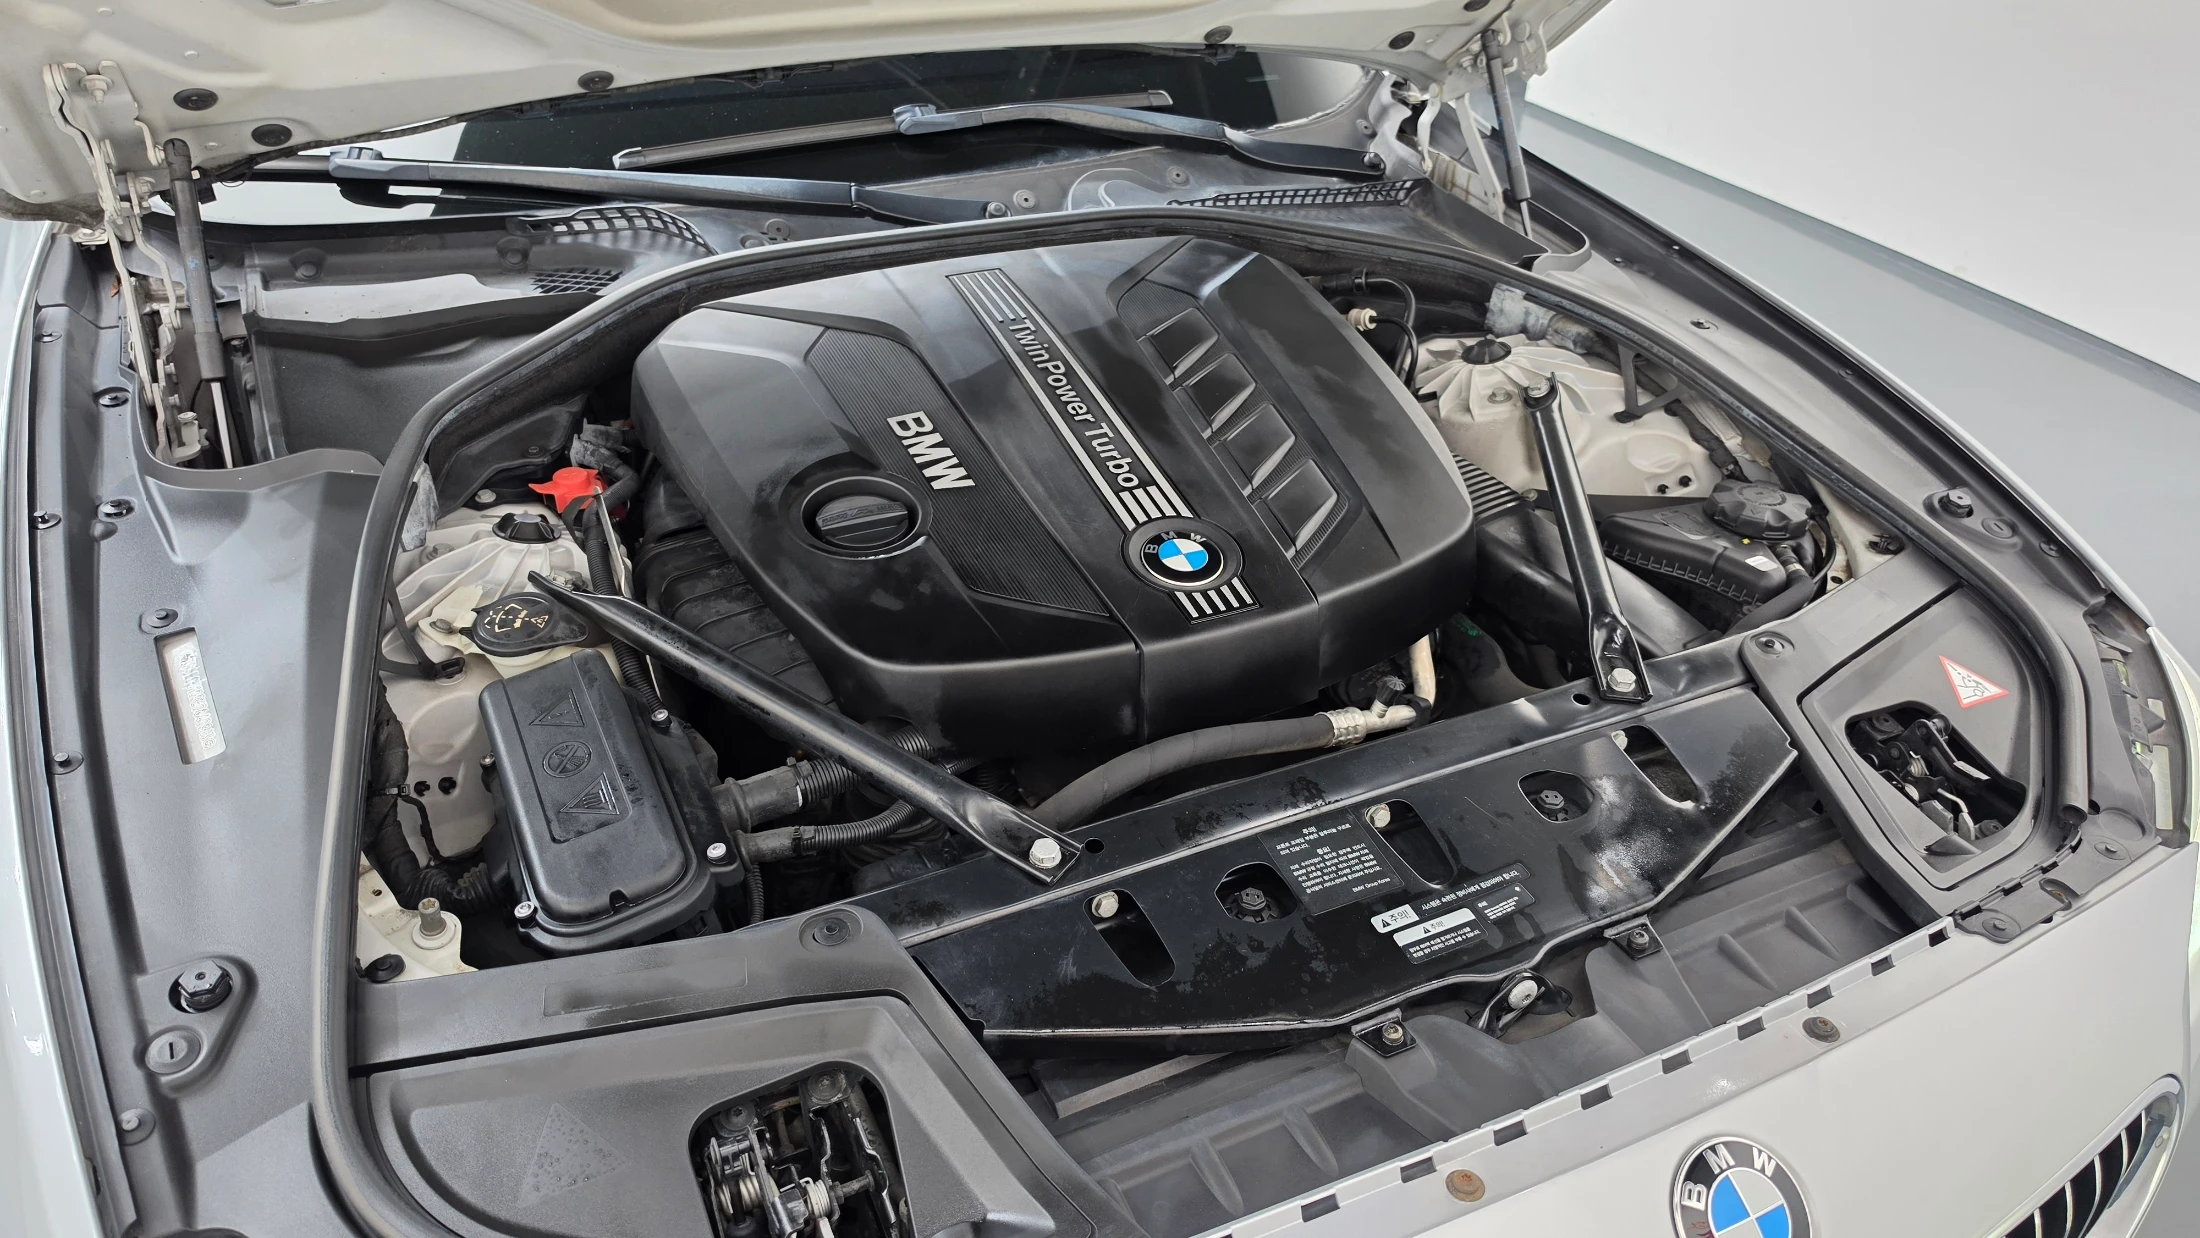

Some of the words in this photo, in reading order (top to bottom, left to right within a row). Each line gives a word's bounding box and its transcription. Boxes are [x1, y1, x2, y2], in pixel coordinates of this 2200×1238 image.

[1008, 319, 1094, 423] TwinPower
[1084, 422, 1139, 488] Turbo
[886, 410, 976, 492] BMW
[1145, 530, 1207, 554] BMW
[1681, 1144, 1776, 1211] BMW
